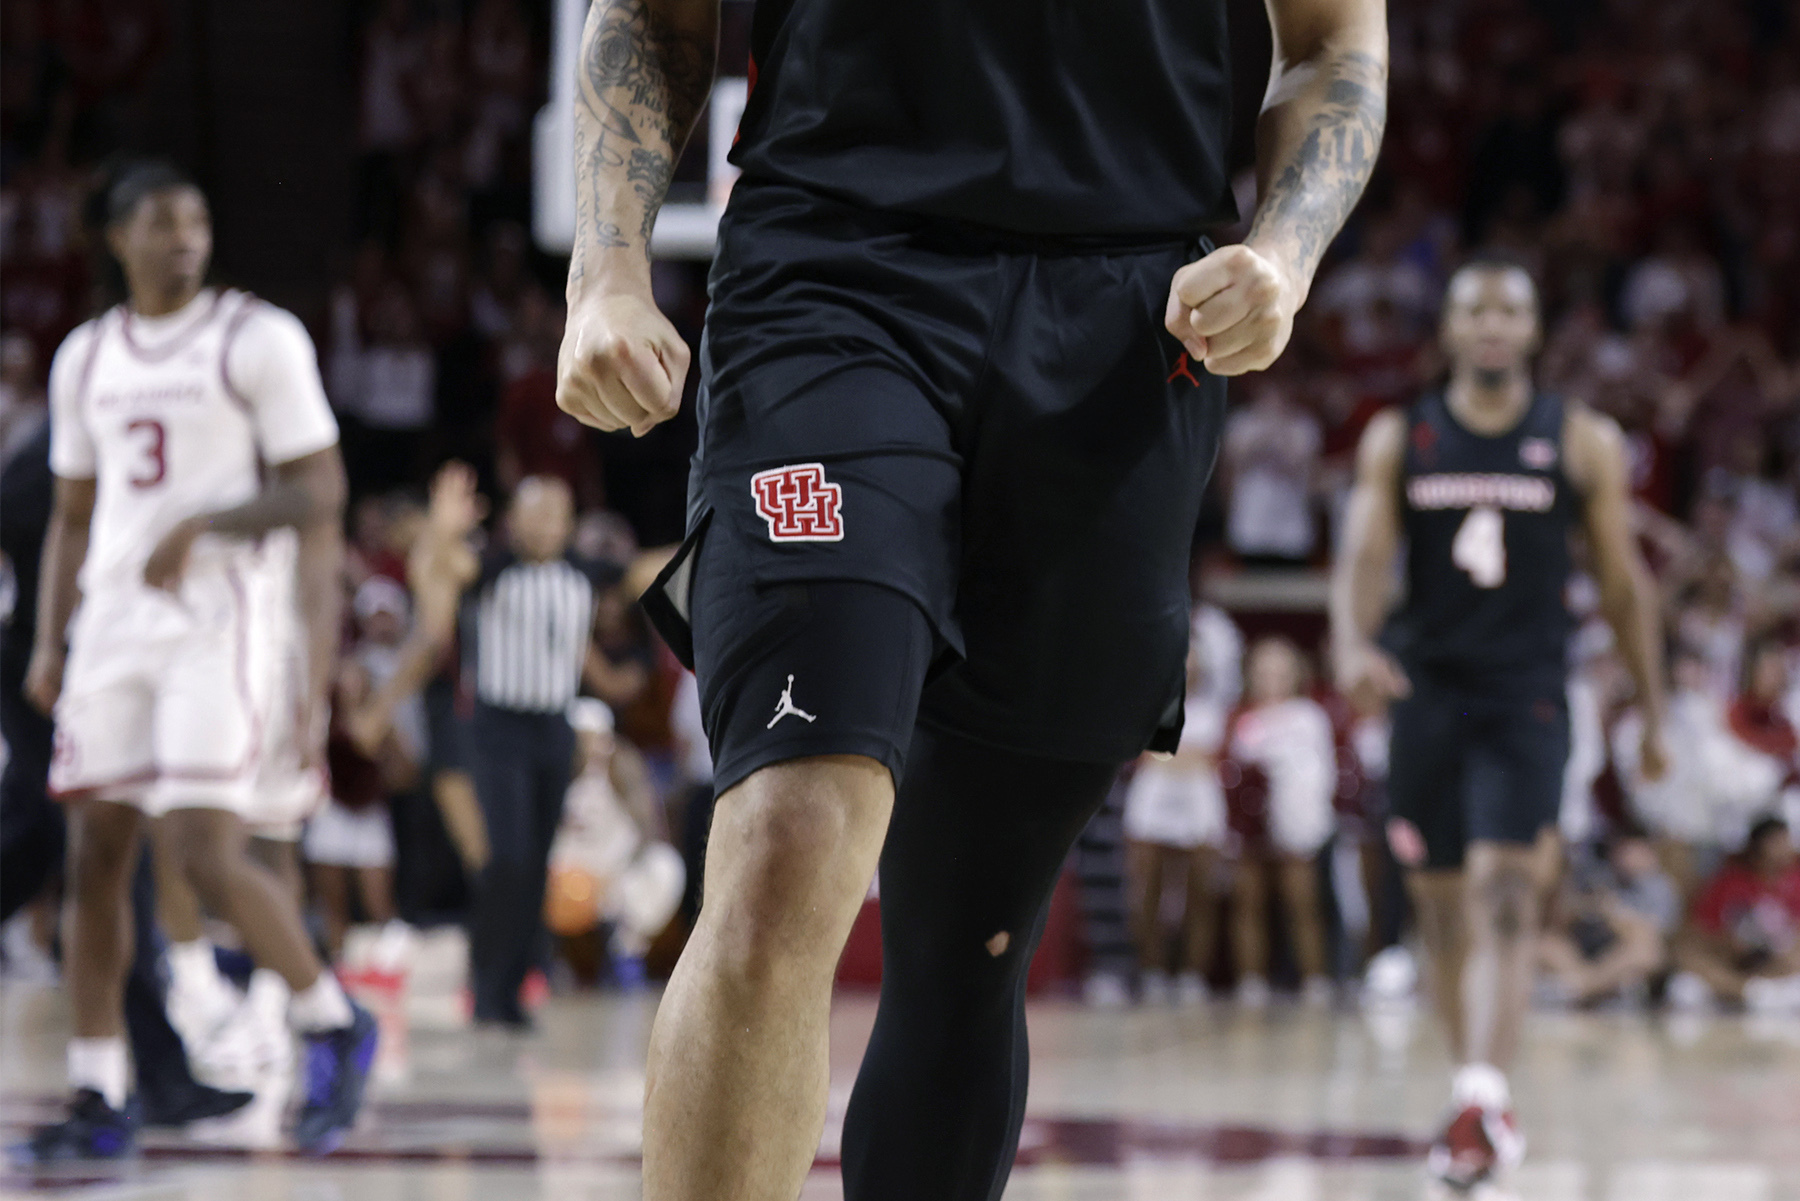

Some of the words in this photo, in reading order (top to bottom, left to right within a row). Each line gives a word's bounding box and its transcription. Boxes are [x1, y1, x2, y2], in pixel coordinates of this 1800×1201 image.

[126, 417, 168, 490] 3
[751, 462, 845, 543] UH
[1452, 506, 1508, 589] 4
